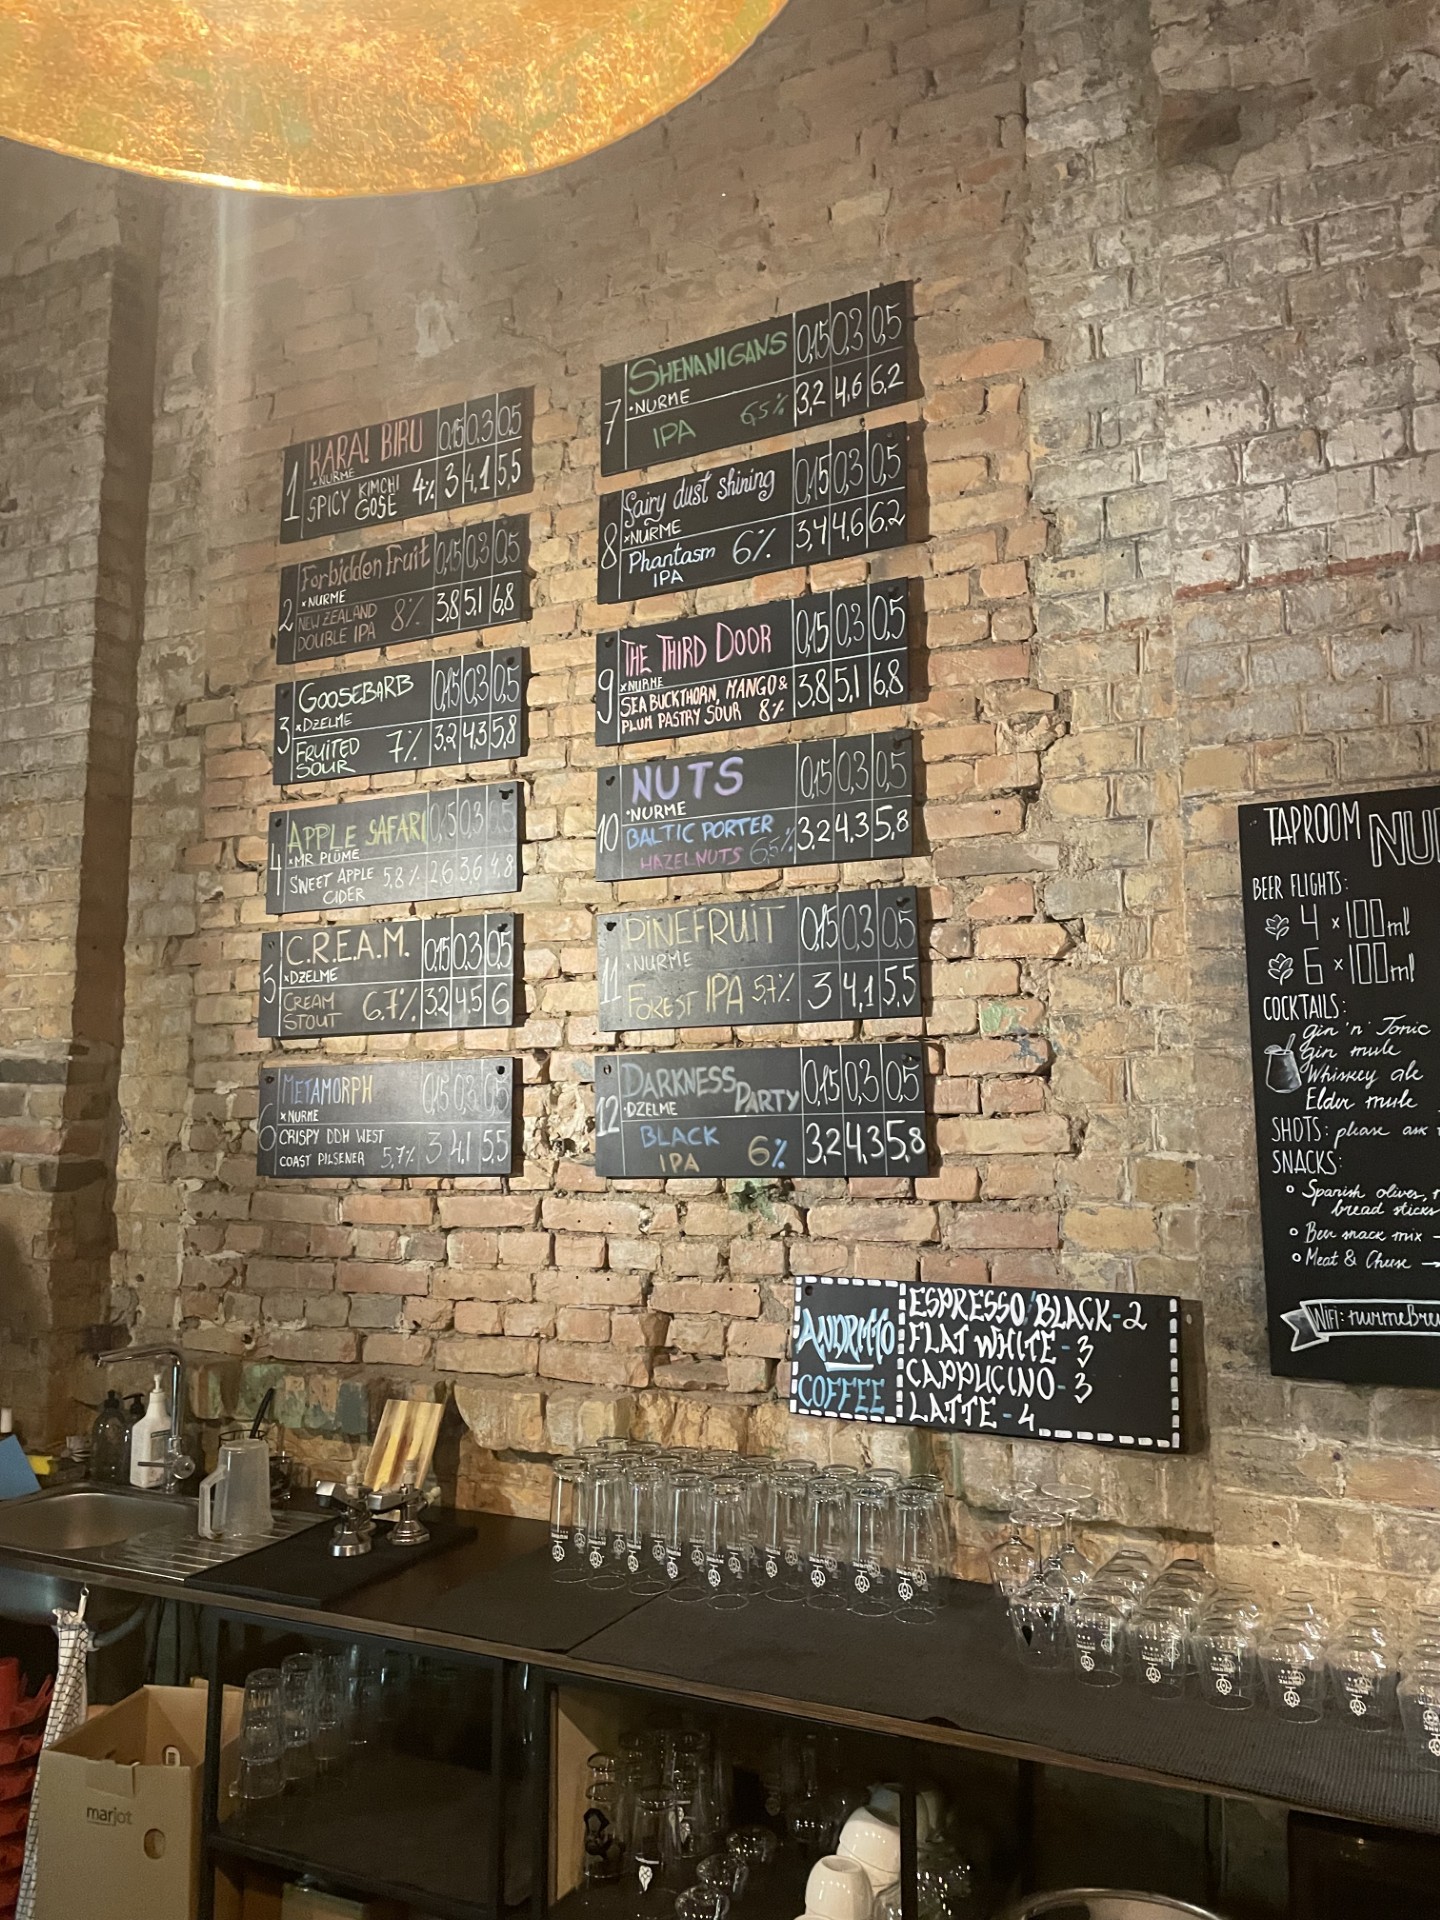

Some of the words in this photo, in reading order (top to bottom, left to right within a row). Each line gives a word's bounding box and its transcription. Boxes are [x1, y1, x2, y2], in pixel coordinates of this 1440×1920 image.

[629, 331, 787, 396] SHENANIGANS
[604, 399, 621, 445] 7
[653, 419, 696, 448] IPA
[310, 428, 369, 480] KARA!
[381, 419, 423, 462] BIRU
[284, 462, 300, 521] 1
[307, 488, 350, 522] SPICY
[358, 474, 399, 499] KIMCHI
[444, 462, 458, 498] 3
[673, 470, 712, 510] dust
[717, 467, 775, 501] shining
[355, 494, 397, 520] GOSE
[301, 552, 382, 591] Forbidden
[387, 537, 430, 576] Fruit
[601, 522, 617, 569] 8
[629, 542, 716, 574] Phantasm
[733, 528, 776, 565] 6%
[654, 569, 683, 587] IPA
[279, 598, 293, 631] 2
[298, 616, 320, 631] NEW
[323, 603, 377, 625] ZEALAND
[298, 628, 347, 651] DOUBLE
[354, 622, 376, 642] IPA
[621, 639, 652, 677] THE
[656, 634, 707, 673] THIRD
[716, 622, 772, 663] DOOR
[299, 674, 414, 713] GOOSEBARB
[597, 668, 614, 724] 9
[621, 696, 647, 718] SEA
[726, 675, 777, 699] MANGO
[621, 718, 653, 734] PLUM
[659, 710, 700, 729] PASTRY
[704, 703, 741, 725] SOUR
[758, 699, 784, 722] 8%
[277, 717, 290, 754] 3
[386, 727, 422, 763] 7%
[296, 760, 355, 778] SOUR
[631, 756, 744, 804] NUTS
[288, 819, 357, 853] APPLE
[365, 811, 427, 846] SAFARI
[598, 813, 618, 852] 10
[627, 824, 695, 849] BALTIC
[702, 814, 774, 841] PORTER
[1263, 801, 1361, 846] TAPROOM
[270, 842, 282, 896] 4
[337, 867, 374, 883] APPLE
[1252, 875, 1283, 900] BEER
[323, 888, 365, 905] CIDER
[1301, 903, 1319, 940] 4
[286, 925, 410, 965] C.R.E.A.M.
[263, 964, 276, 1004] 5
[601, 956, 622, 1005] 11
[1304, 947, 1323, 985] 6
[283, 992, 334, 1012] CREAM
[492, 983, 509, 1015] 6
[627, 984, 699, 1020] FOREST
[706, 973, 743, 1014] IPA
[807, 972, 832, 1009] 3
[283, 1012, 342, 1031] STOUT
[1376, 1015, 1431, 1035] Tonic
[1351, 1039, 1401, 1057] mule
[282, 1075, 373, 1105] METAMORPH
[622, 1063, 737, 1100] DARKNESS
[734, 1082, 799, 1113] PARTY
[1308, 1064, 1378, 1089] Whiskey
[1391, 1060, 1423, 1081] ale
[597, 1095, 620, 1136] 12
[1306, 1087, 1355, 1110] Elder
[1365, 1089, 1418, 1109] mule
[259, 1103, 276, 1151] 6
[279, 1129, 320, 1145] CRISPY
[327, 1130, 349, 1143] DDH
[356, 1129, 384, 1143] WEST
[640, 1125, 720, 1147] BLACK
[1334, 1121, 1390, 1149] please
[1403, 1126, 1428, 1136] ask
[279, 1154, 312, 1167] COAST
[318, 1152, 365, 1166] PILSENER
[425, 1131, 442, 1165] 3
[659, 1153, 700, 1173] IPA
[748, 1135, 787, 1169] 6%
[1302, 1179, 1365, 1207] Spanish
[1331, 1199, 1385, 1216] bread
[1393, 1202, 1440, 1216] sticks
[1342, 1231, 1387, 1242] snack
[1392, 1228, 1423, 1242] mix
[1306, 1247, 1338, 1267] Meat
[1344, 1249, 1357, 1266] &
[909, 1287, 1025, 1326] ESPRESSO
[909, 1322, 969, 1355] FLAT
[974, 1330, 1056, 1364] WHITE
[1077, 1335, 1094, 1368] 3
[798, 1374, 885, 1414] COFFEE
[906, 1359, 1054, 1400] CAPPUCINO
[1075, 1372, 1092, 1404] 3
[910, 1392, 997, 1429] LATTE
[1018, 1404, 1035, 1431] 4
[86, 1805, 133, 1826] marjot
